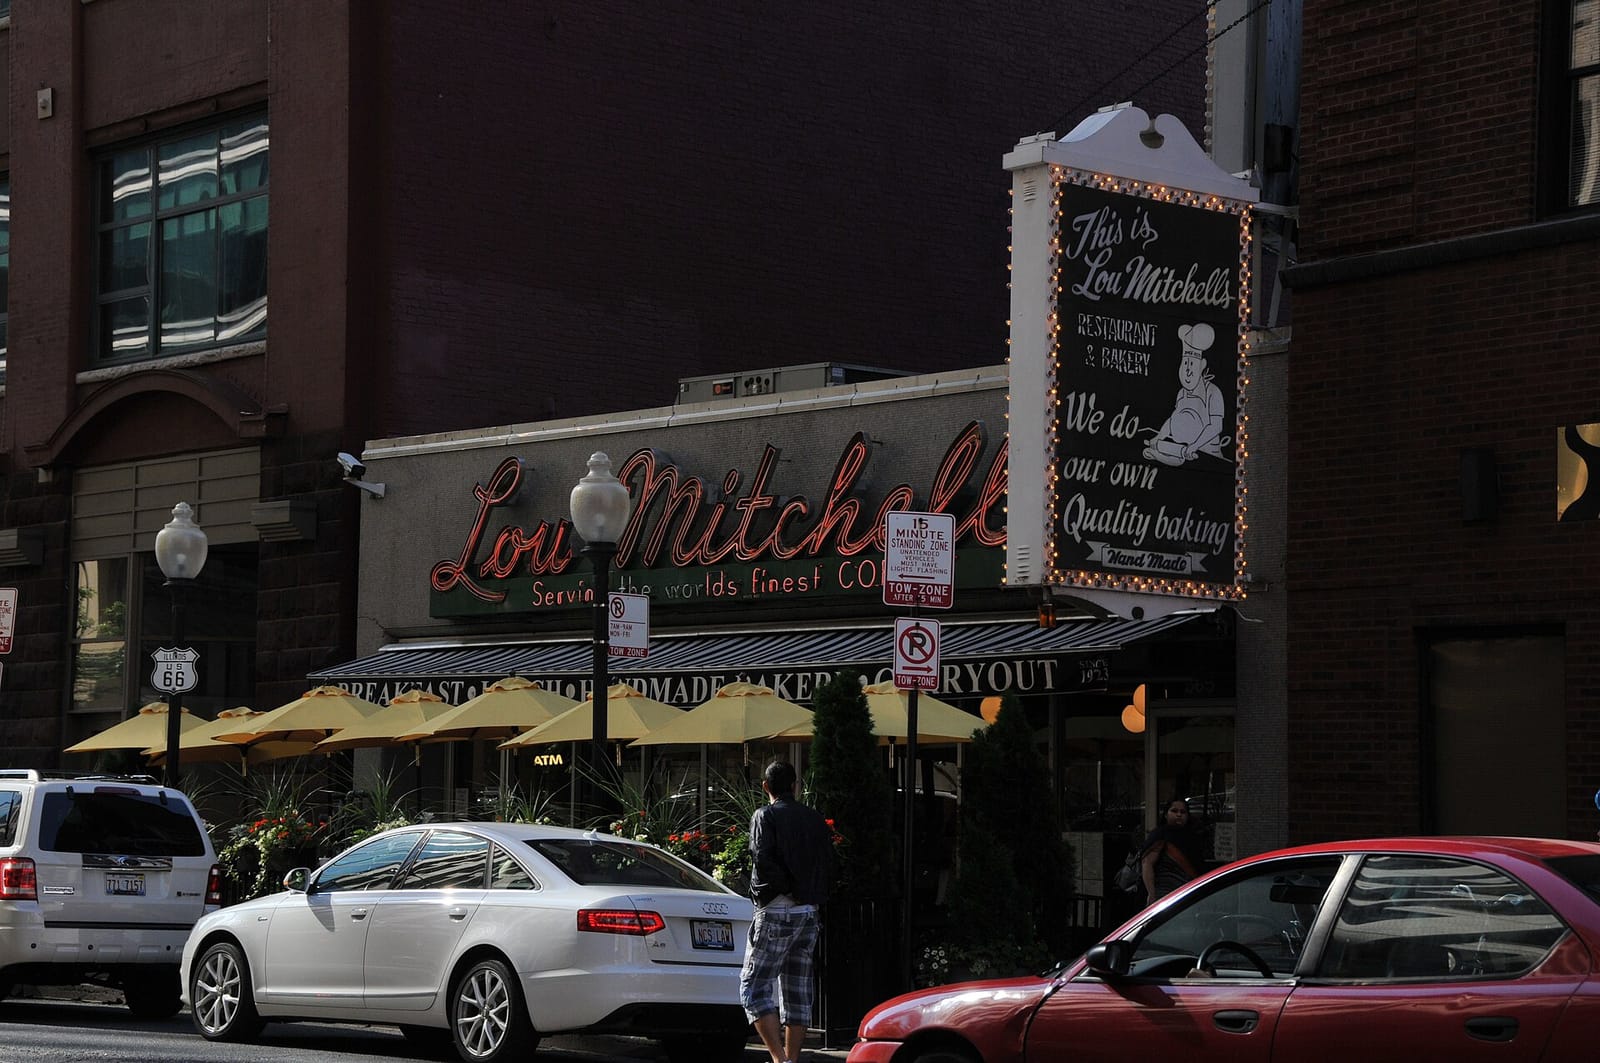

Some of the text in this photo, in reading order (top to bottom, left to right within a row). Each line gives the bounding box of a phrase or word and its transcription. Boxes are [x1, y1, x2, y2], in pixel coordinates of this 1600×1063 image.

[1066, 205, 1158, 260] This is
[1072, 247, 1236, 310] Lou Mitchells
[1078, 313, 1158, 347] RESTAURANT
[1085, 344, 1151, 376] & BAKERY
[1066, 391, 1140, 439] We do
[1064, 457, 1158, 490] our own
[430, 420, 1009, 602] Lou Mitchell
[912, 518, 929, 529] 15
[1063, 492, 1231, 556] Quality baking
[896, 528, 945, 540] MINUTE
[891, 538, 949, 551] STANDING ZONE
[900, 549, 940, 557] UNATTENDED
[1107, 549, 1187, 571] Hand Made
[890, 565, 948, 575] LIGHTS FLASHING
[532, 580, 595, 607] Servin
[665, 571, 738, 600] worlds
[752, 565, 823, 594] finest
[889, 582, 949, 596] TOW-ZONE
[893, 594, 914, 602] AFTER
[609, 647, 646, 657] TOW ZONE
[163, 671, 184, 687] 66
[896, 675, 936, 687] TOW-ZONE
[338, 681, 465, 706] BREAKAST
[534, 754, 563, 766] ATM
[107, 879, 143, 891] 771 7157
